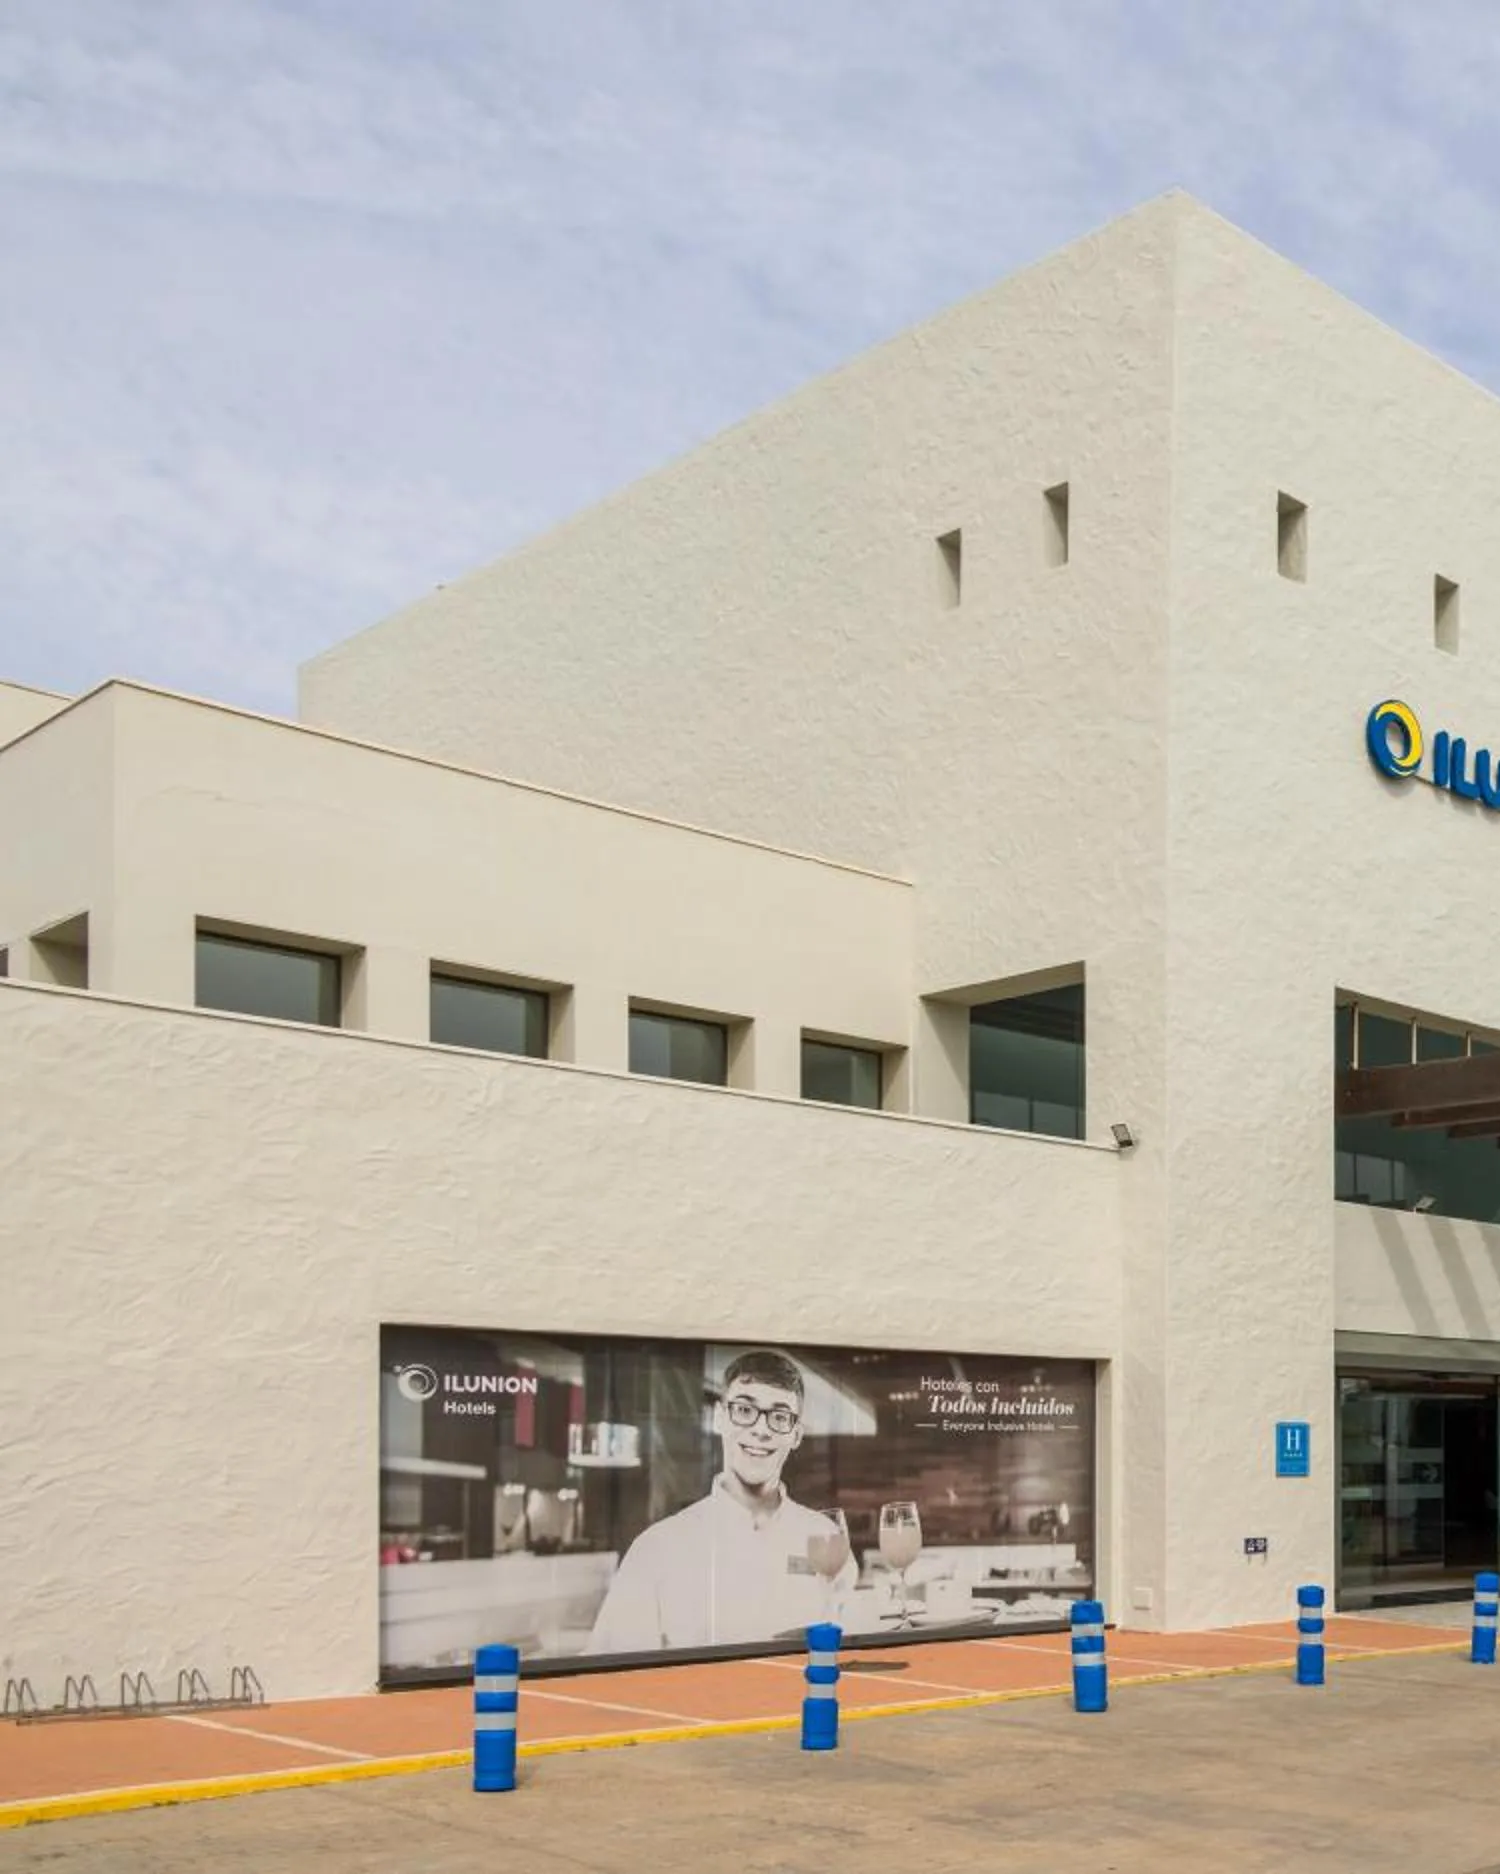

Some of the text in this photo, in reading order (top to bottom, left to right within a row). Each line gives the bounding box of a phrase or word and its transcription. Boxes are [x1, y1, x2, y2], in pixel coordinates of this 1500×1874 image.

[443, 1374, 537, 1394] ILUNION
[920, 1376, 1000, 1393] Hoteles con
[443, 1401, 497, 1415] Hotels
[928, 1395, 1076, 1416] Todos Incluidos
[942, 1419, 986, 1433] Everyone
[1286, 1428, 1301, 1451] H
